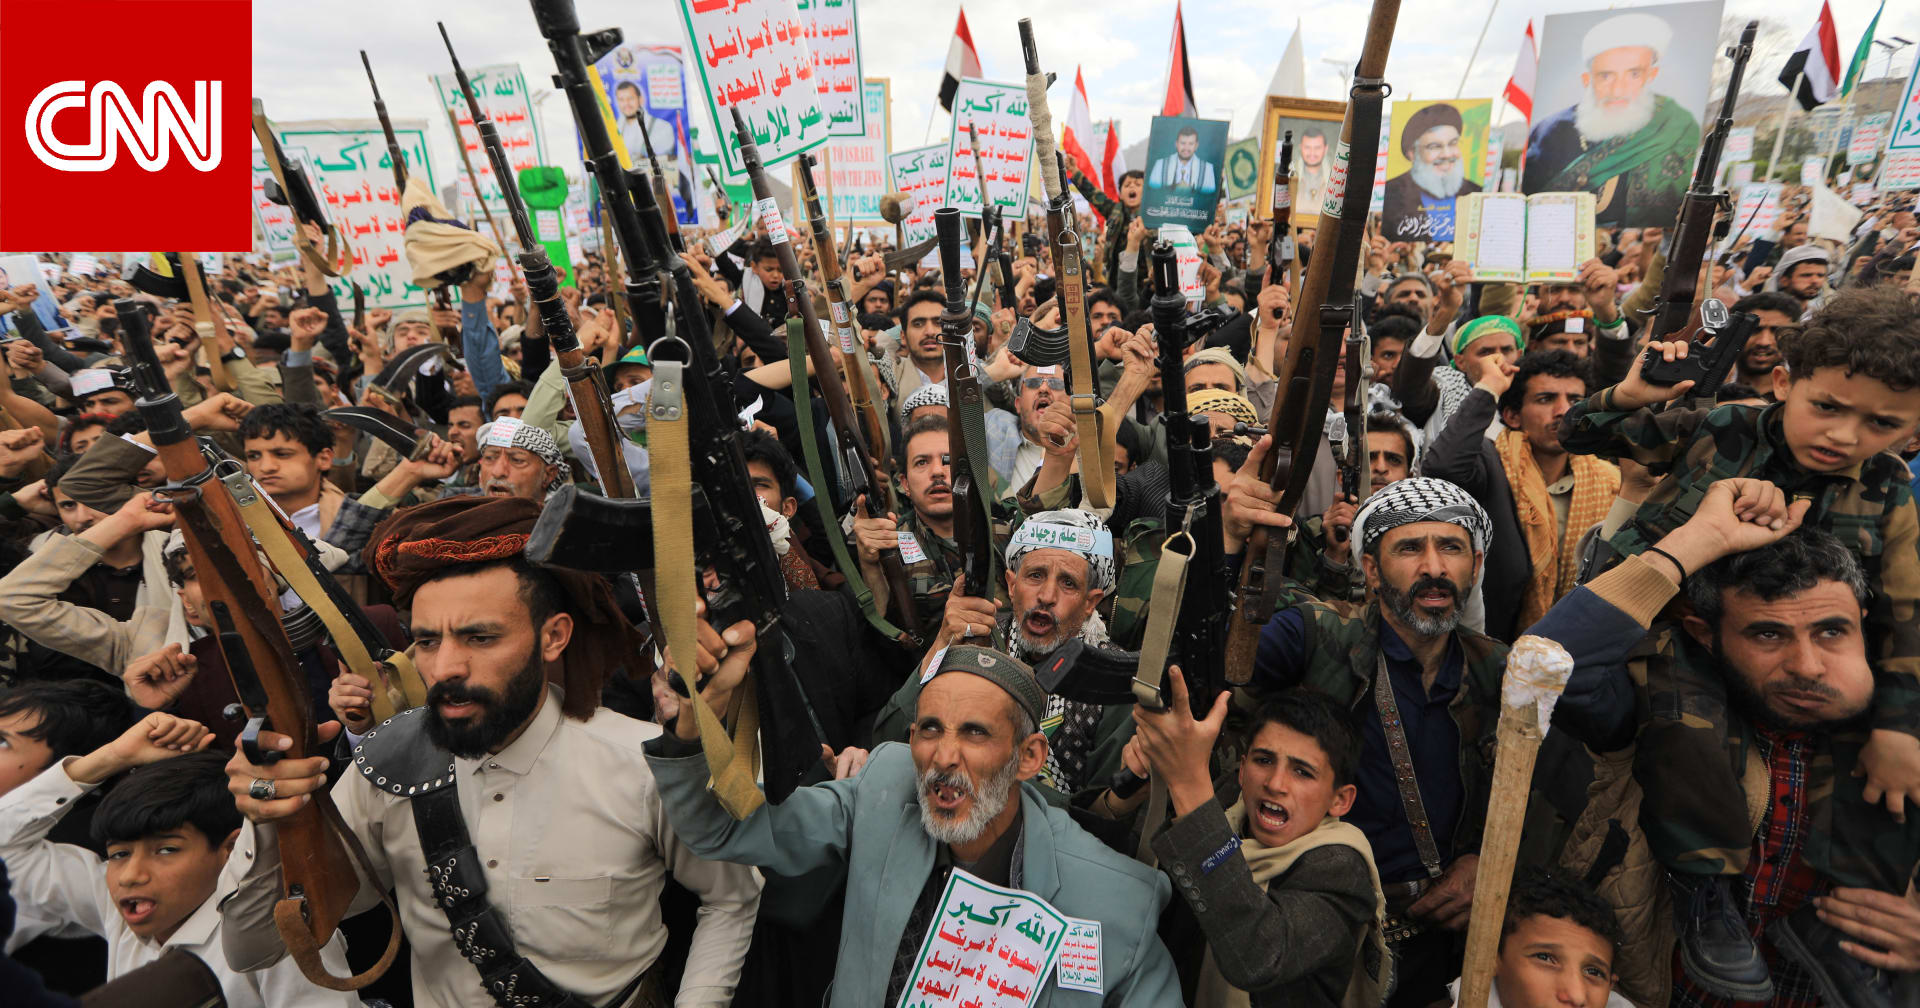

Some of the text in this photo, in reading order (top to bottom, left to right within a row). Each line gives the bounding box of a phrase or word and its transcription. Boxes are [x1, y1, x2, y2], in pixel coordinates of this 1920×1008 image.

[706, 17, 773, 68] لإسرائيل
[821, 17, 853, 41] الموت
[823, 48, 855, 70] الموت
[494, 73, 521, 96] الله
[717, 68, 766, 107] اليهود
[771, 61, 792, 97] على
[826, 100, 859, 129] النصر
[960, 88, 1028, 118] لله أكبر
[999, 124, 1032, 141] الموت
[313, 136, 370, 183] أكب
[379, 143, 422, 173] اله
[845, 145, 876, 163] ISRAEL
[897, 153, 925, 180] أكبر
[322, 179, 373, 209] لأمريك
[993, 187, 1024, 207] النصر
[375, 245, 398, 268] على
[1030, 525, 1057, 543] وجهاد
[947, 899, 1057, 951] الله أكبر
[938, 921, 1042, 979] الموت لأمريكا
[916, 976, 960, 1002] اليهود
[926, 950, 1032, 1006] الموت لإسرائيل
